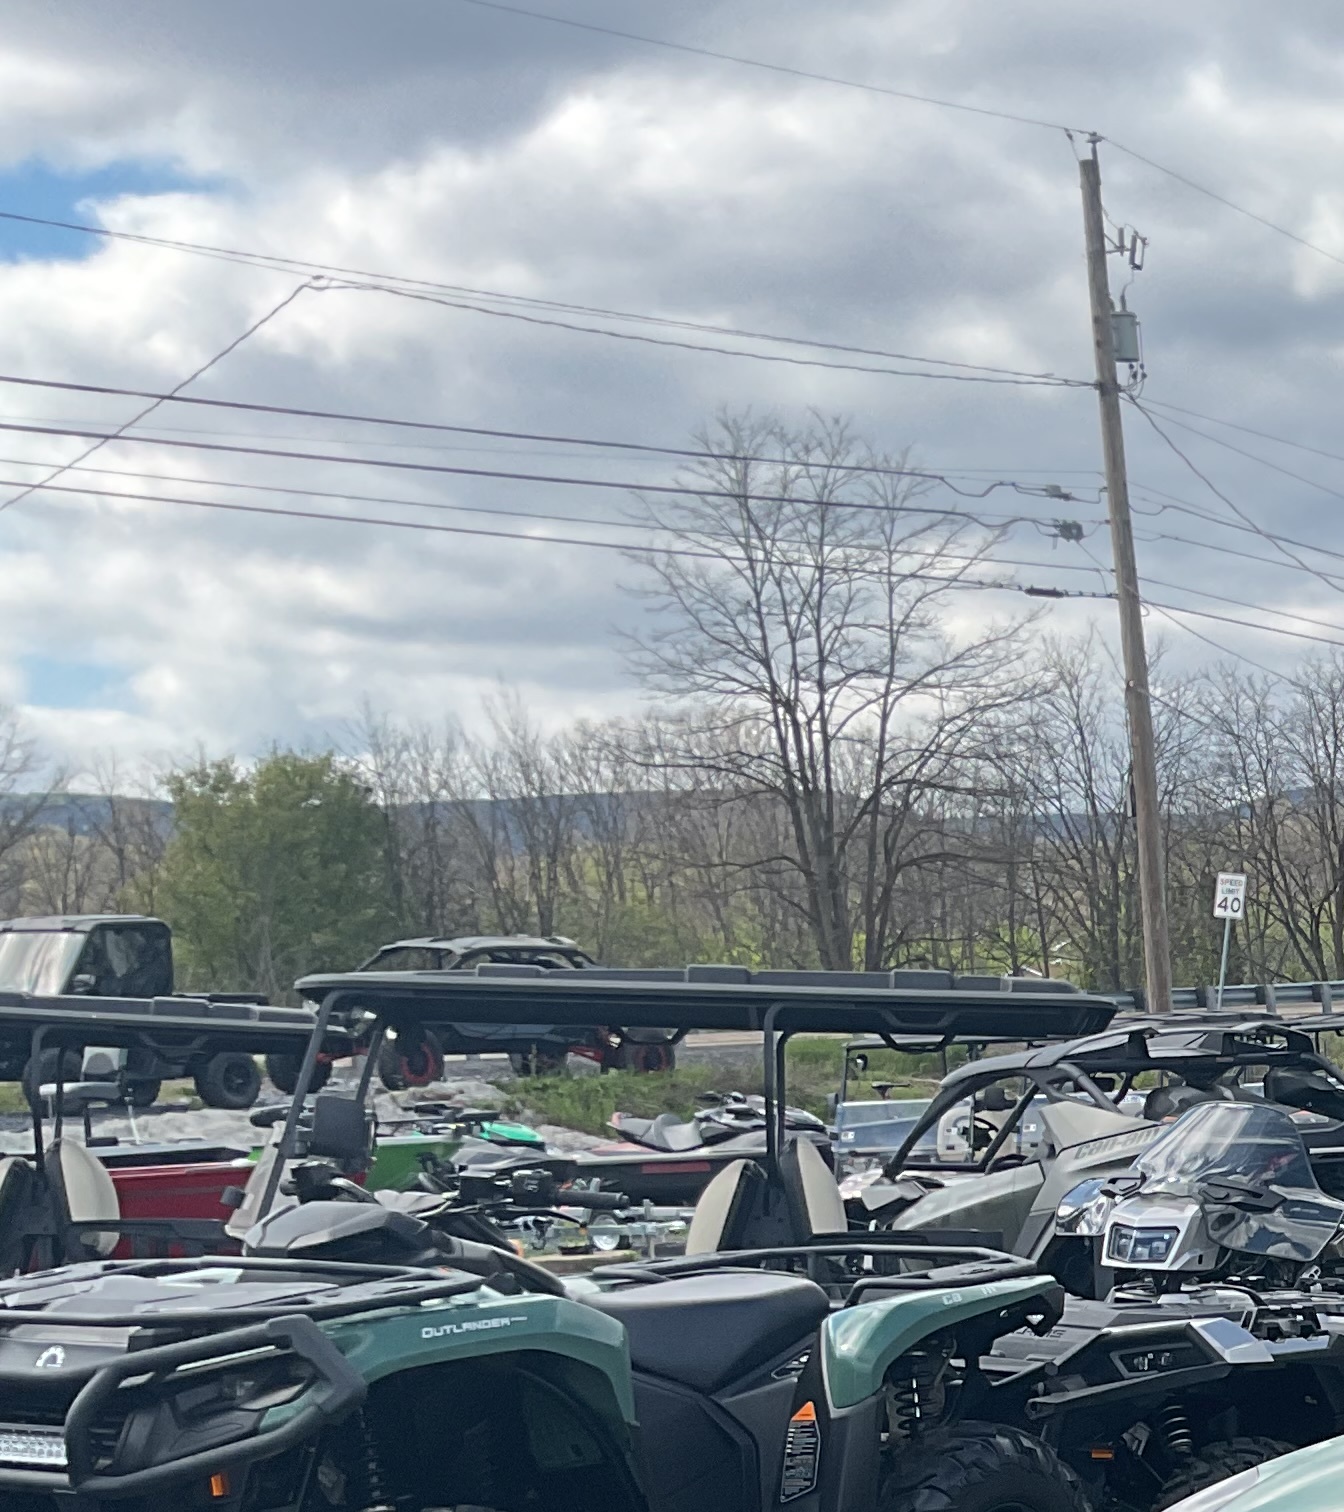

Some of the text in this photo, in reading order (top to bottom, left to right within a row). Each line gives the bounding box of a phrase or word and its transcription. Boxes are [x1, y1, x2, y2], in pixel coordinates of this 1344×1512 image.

[1220, 879, 1243, 887] SPEED
[1217, 896, 1241, 913] 40
[422, 1317, 511, 1339] OUTLANDER
